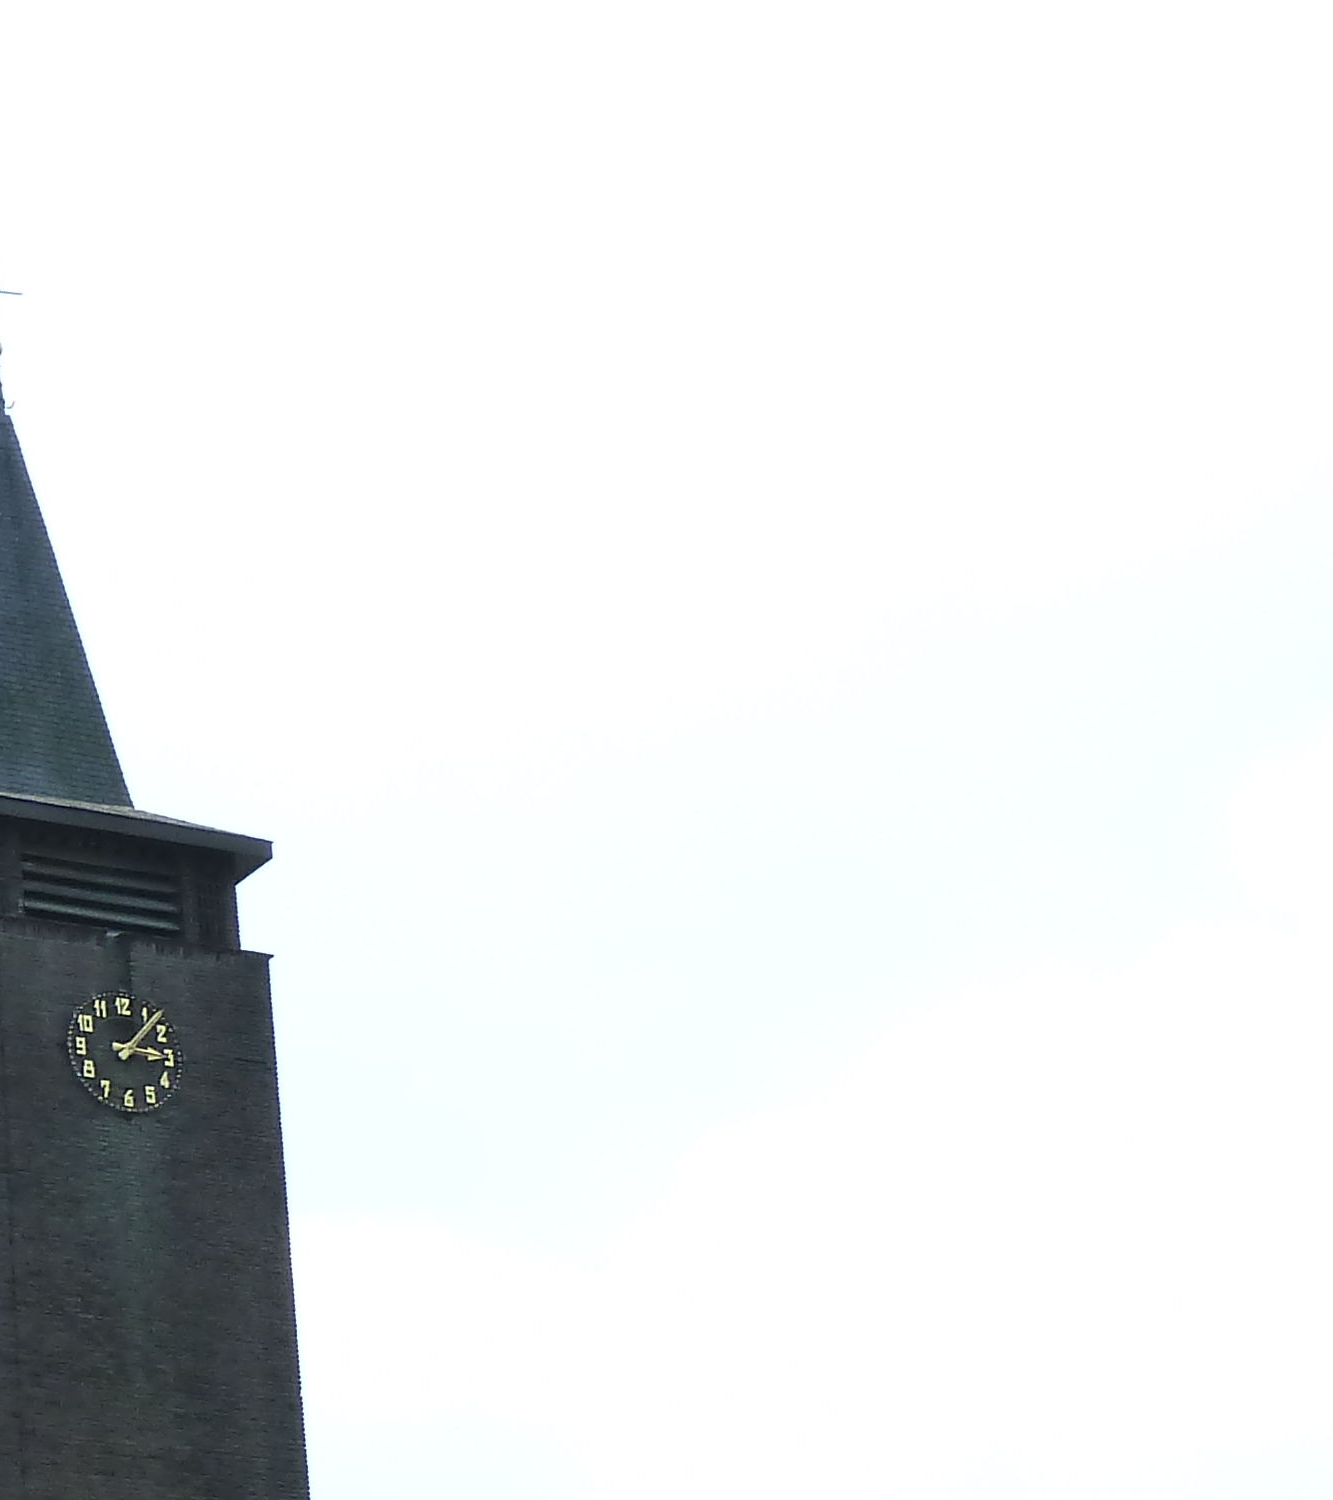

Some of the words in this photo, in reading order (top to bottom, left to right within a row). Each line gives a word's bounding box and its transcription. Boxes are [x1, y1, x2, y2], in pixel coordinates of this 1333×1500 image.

[94, 999, 107, 1018] 11
[115, 997, 131, 1016] 12
[77, 1014, 93, 1033] 10
[156, 1024, 168, 1043] 2
[75, 1036, 87, 1055] 9
[163, 1048, 175, 1067] 3
[83, 1059, 95, 1078] 8
[100, 1079, 111, 1098] 7
[160, 1071, 170, 1089] 4
[124, 1089, 134, 1107] 6
[145, 1085, 156, 1104] 5
